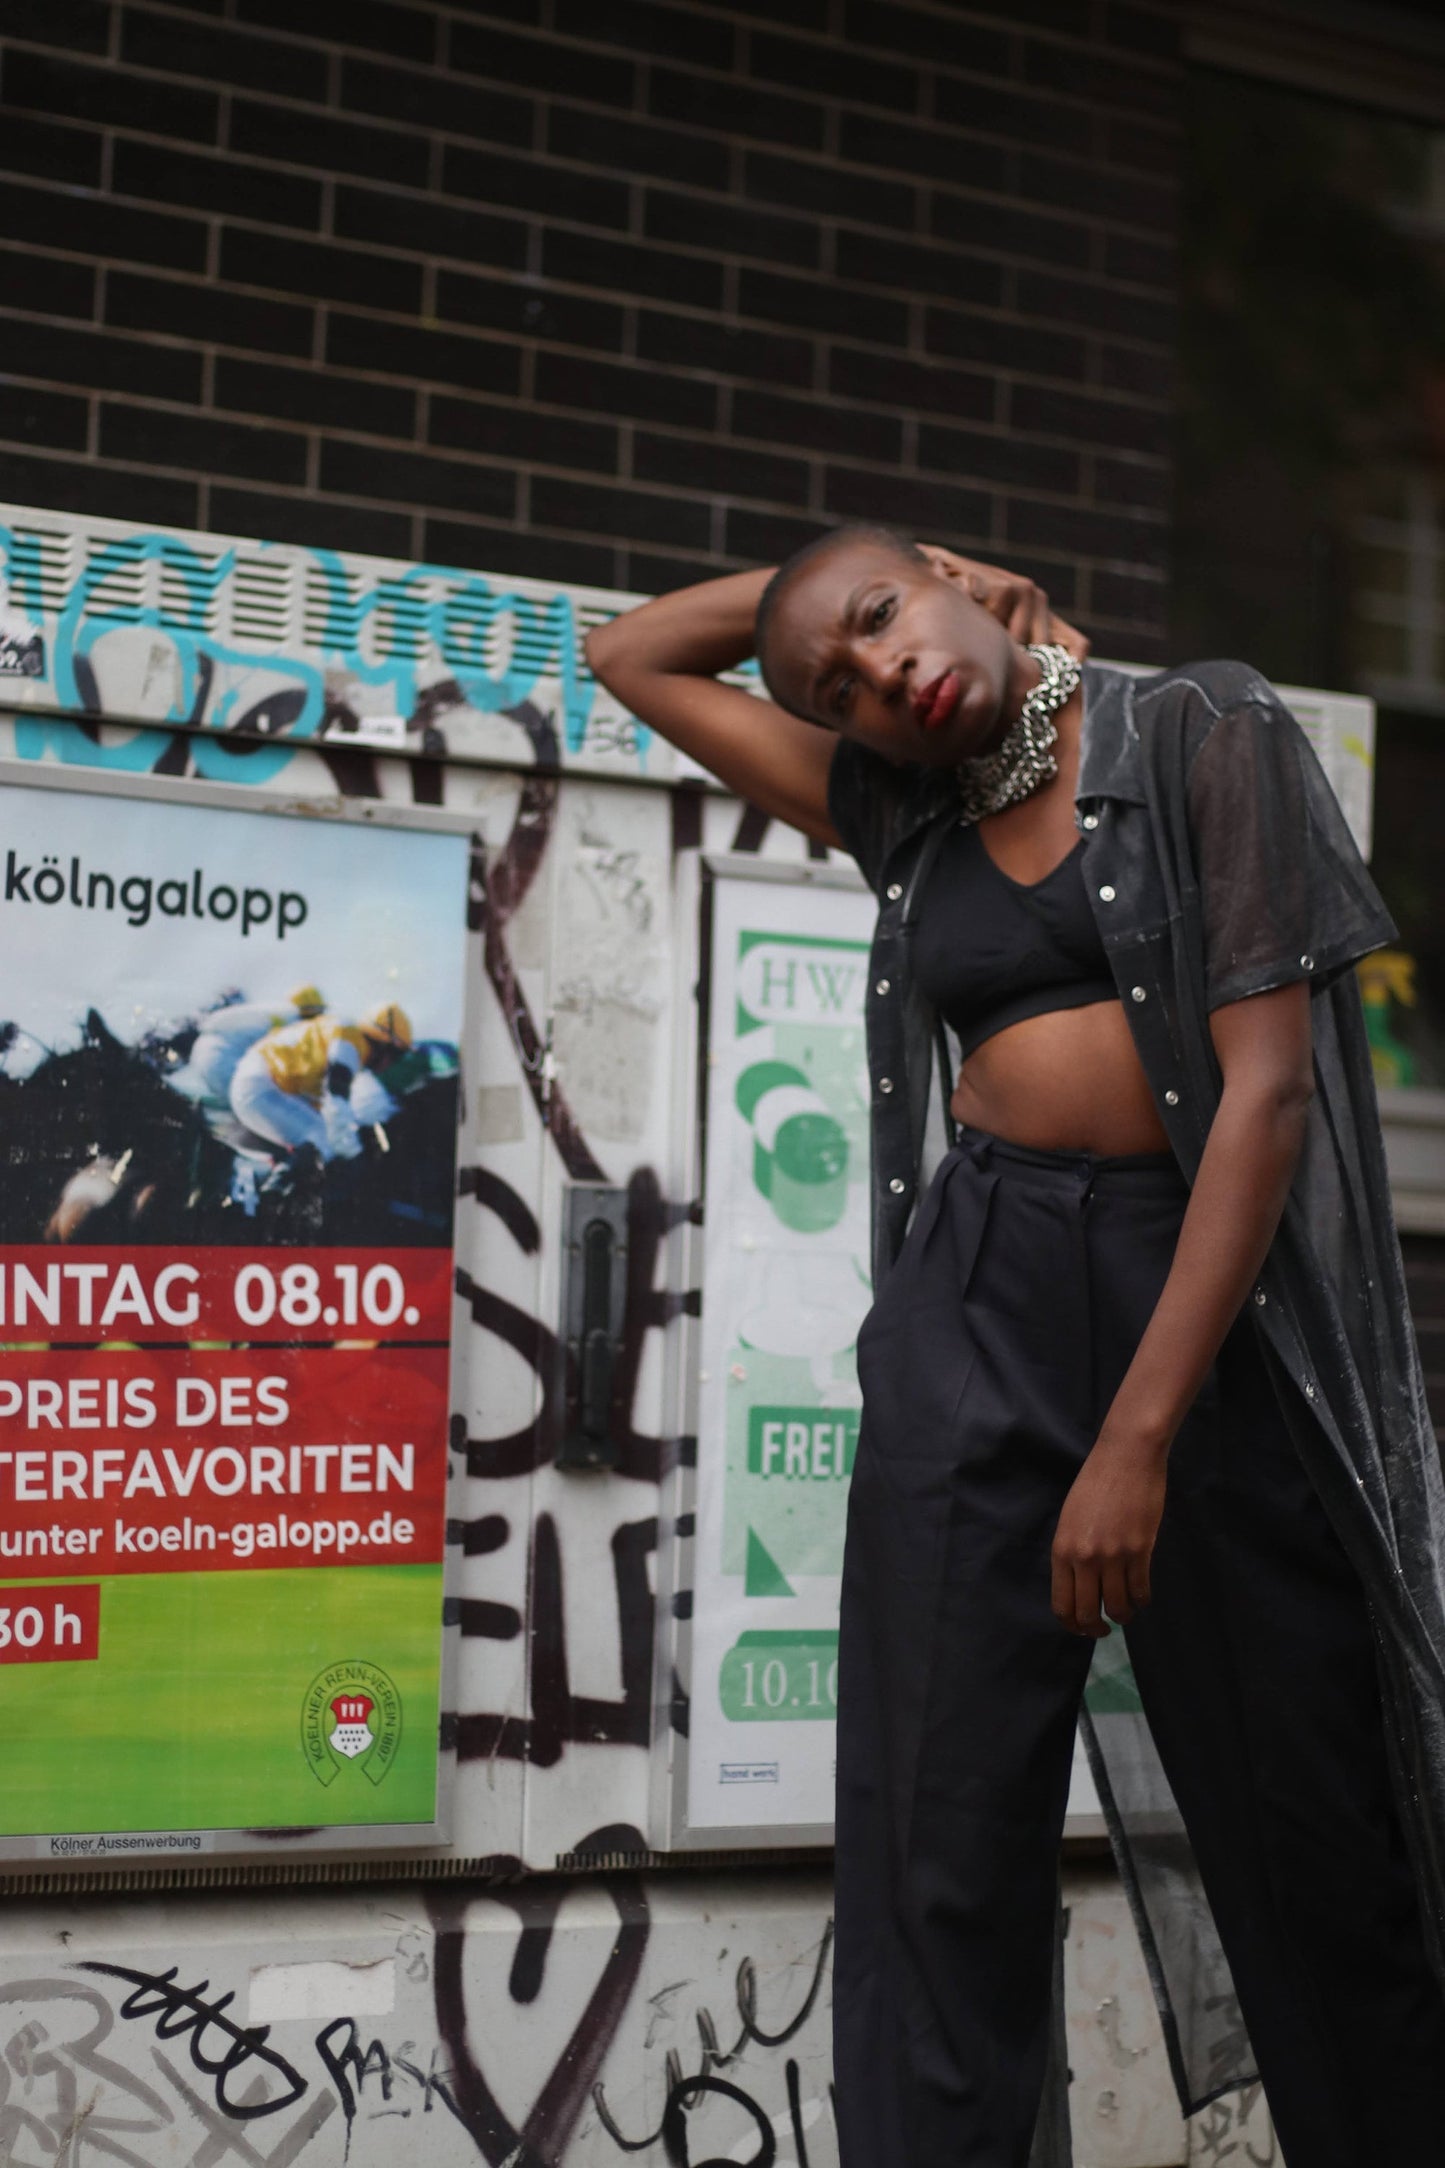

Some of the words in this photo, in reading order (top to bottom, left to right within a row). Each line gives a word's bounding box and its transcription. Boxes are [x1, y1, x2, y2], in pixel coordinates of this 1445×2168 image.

[5, 850, 308, 940] kölngalopp
[0, 1263, 199, 1326] NTAG
[234, 1263, 420, 1326] 08.10.
[176, 1377, 289, 1428] DES
[1, 1525, 102, 1557] unter
[114, 1511, 415, 1556] koeln-galopp.de
[54, 1603, 82, 1646] h
[50, 1837, 94, 1851] Kölner
[97, 1835, 201, 1849] Aussenwerbung
